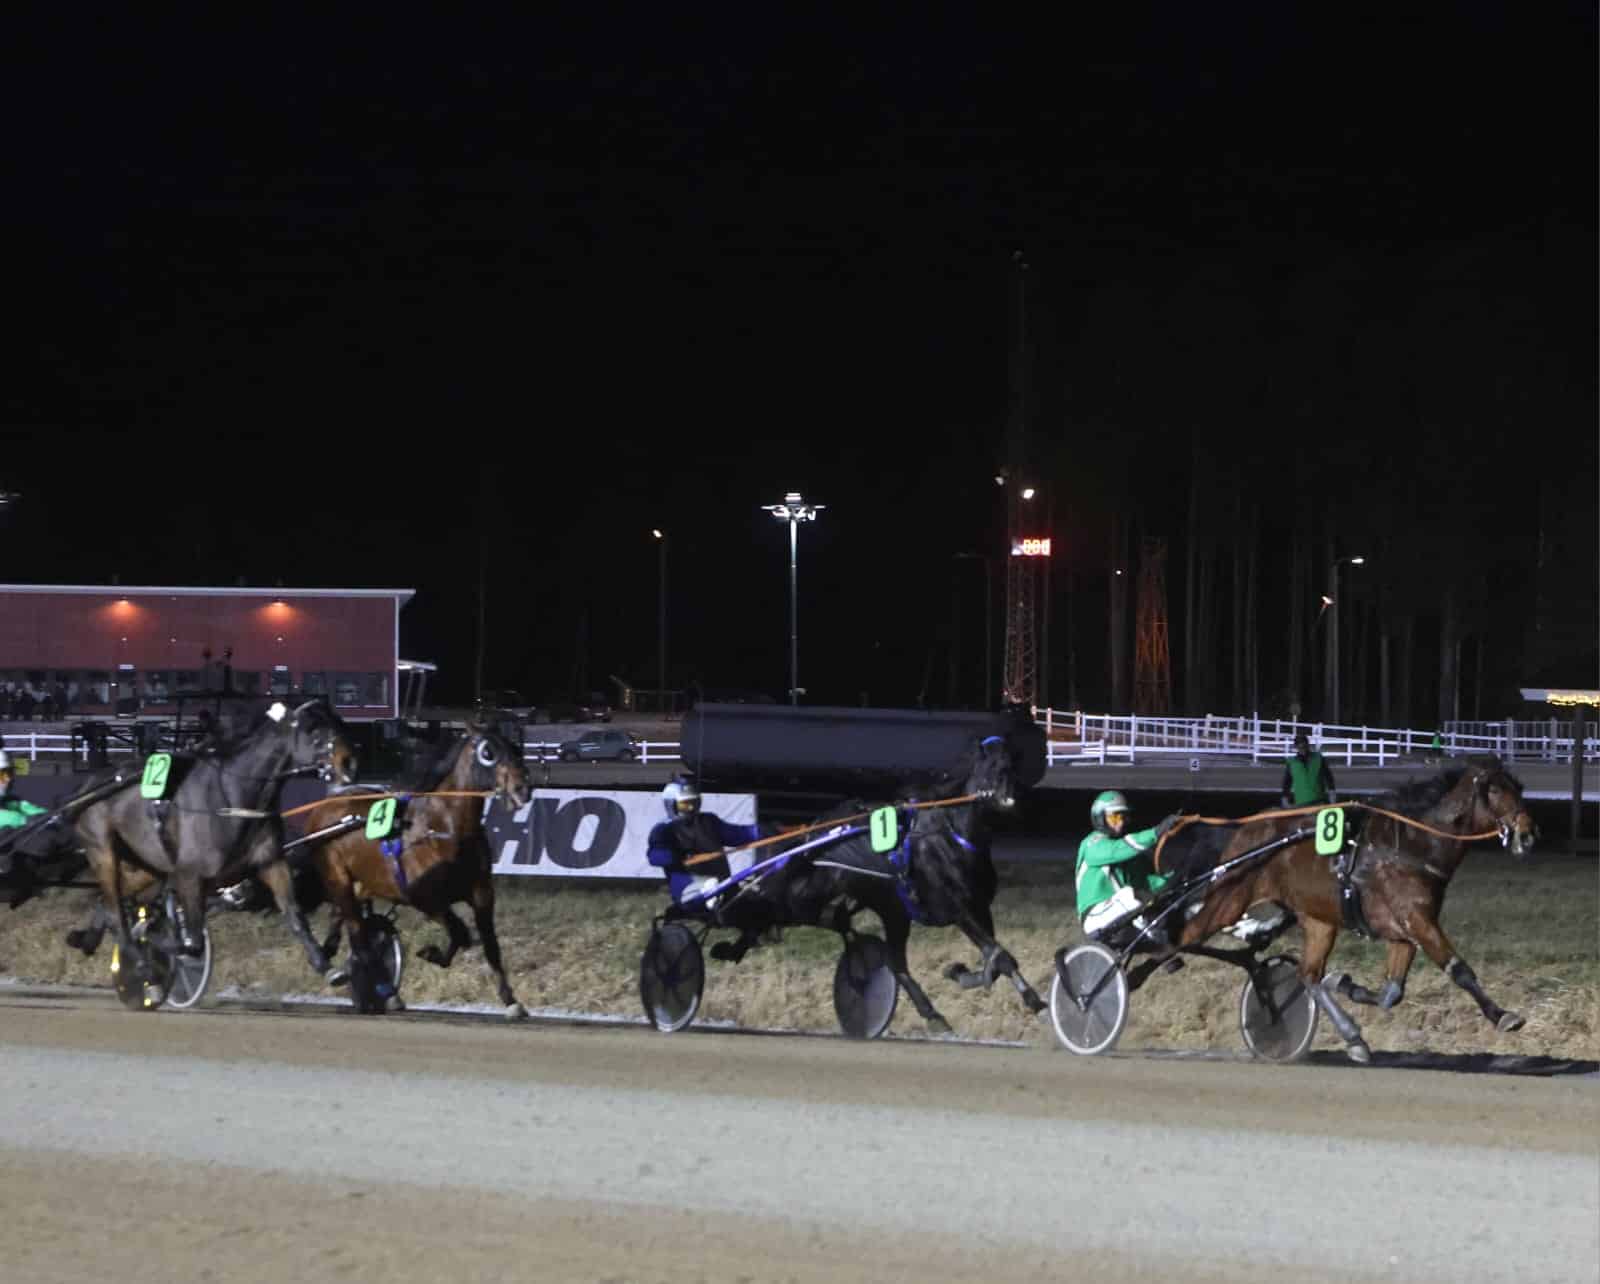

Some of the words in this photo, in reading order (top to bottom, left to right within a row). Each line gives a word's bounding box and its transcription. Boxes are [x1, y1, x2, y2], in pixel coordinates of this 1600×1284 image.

[146, 756, 169, 785] 12
[373, 801, 387, 825] 4
[880, 810, 887, 838] 1
[1323, 811, 1338, 842] 8
